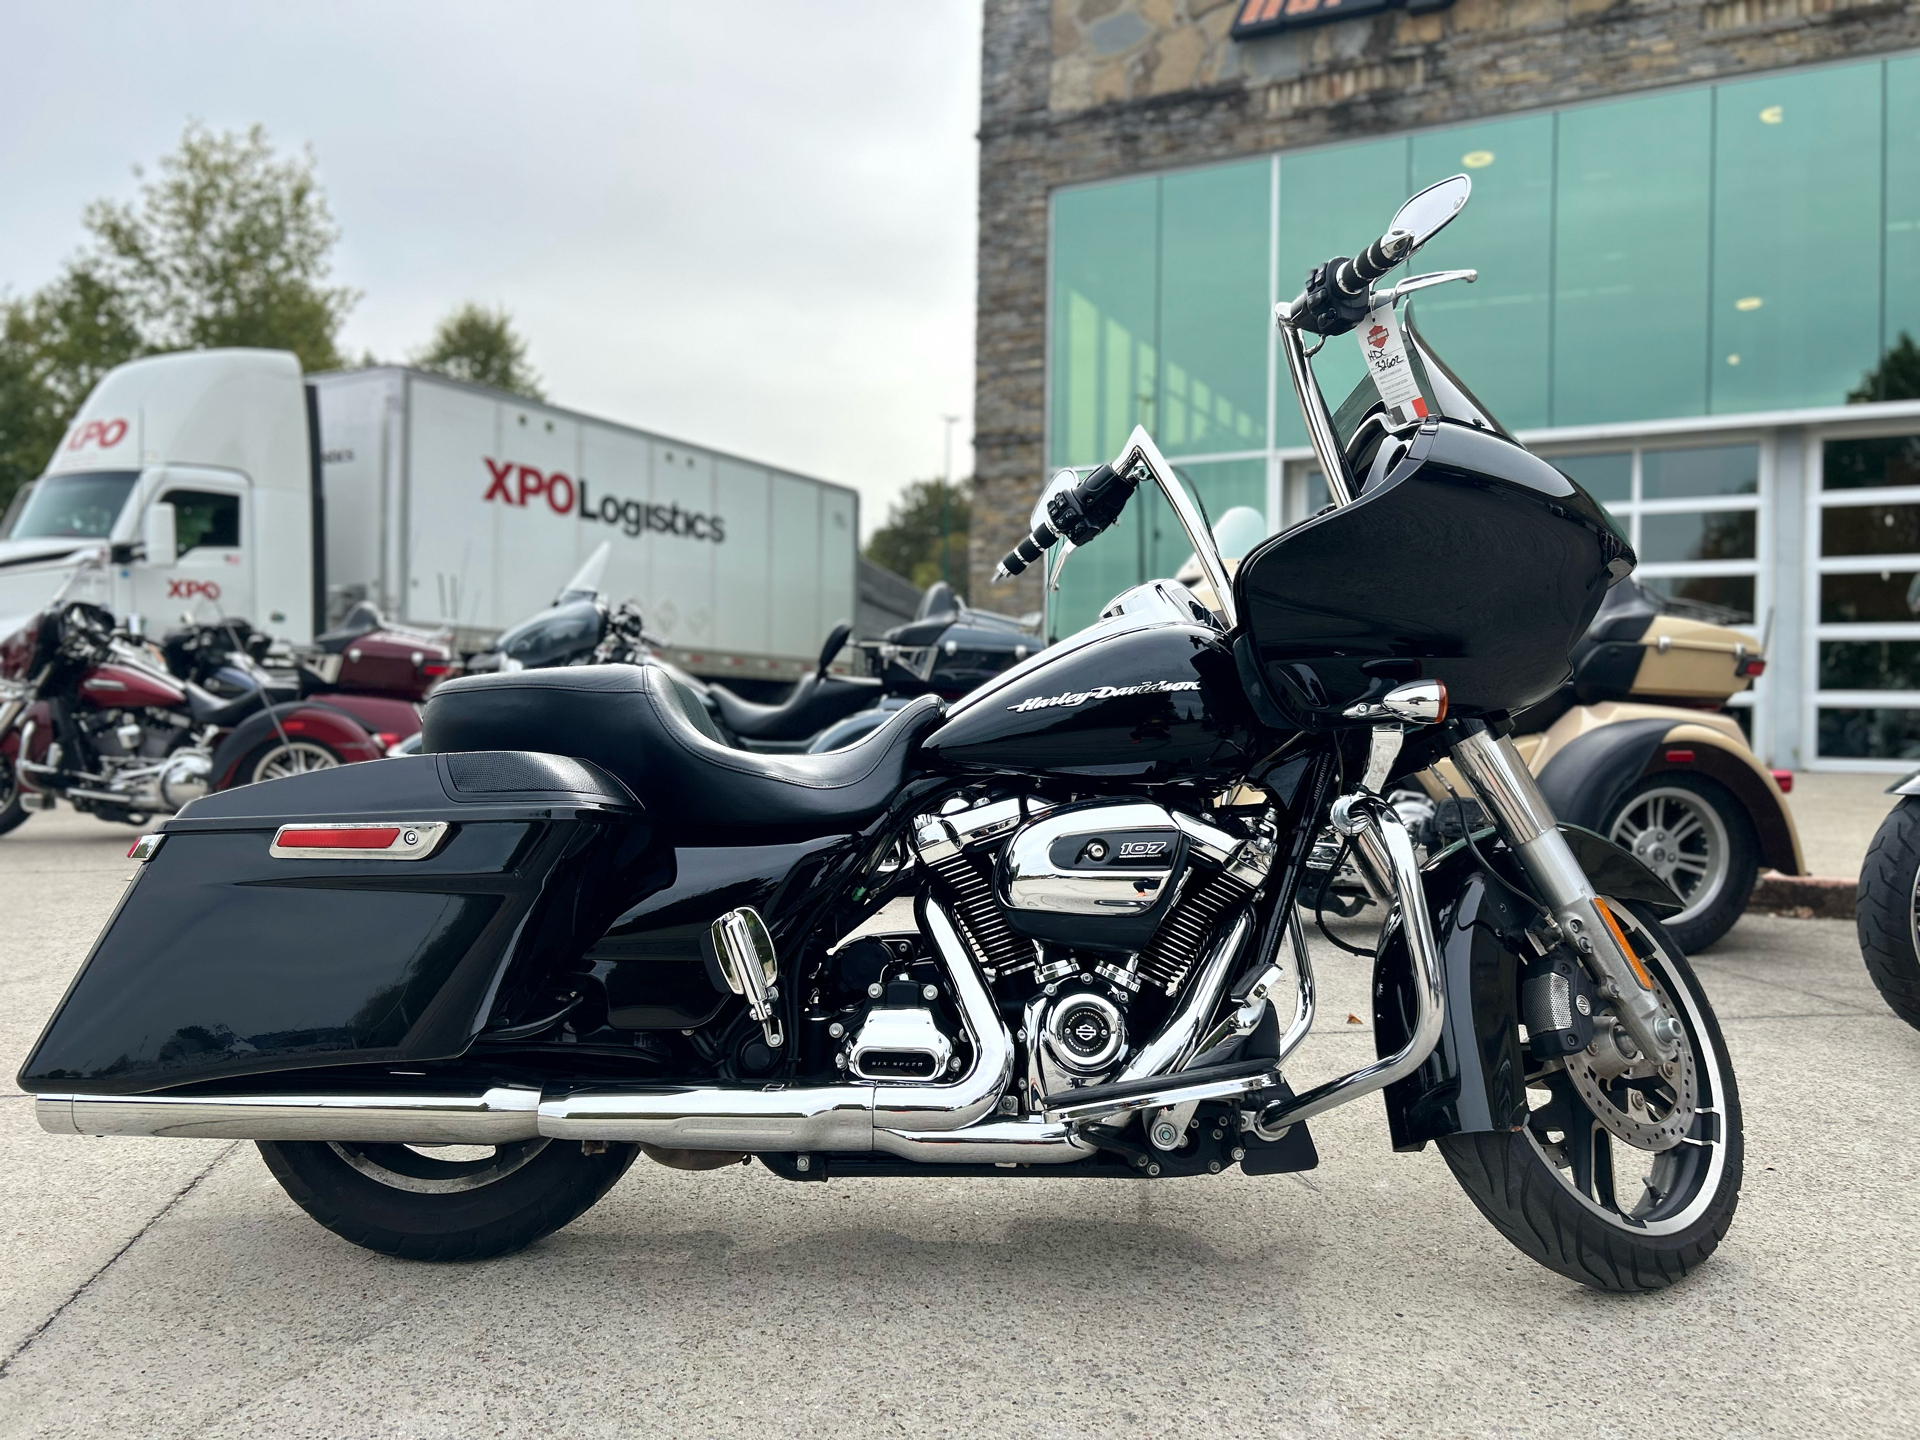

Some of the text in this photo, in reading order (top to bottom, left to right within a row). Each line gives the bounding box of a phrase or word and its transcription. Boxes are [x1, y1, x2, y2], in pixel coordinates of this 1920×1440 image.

[1368, 348, 1387, 361] HDC
[483, 456, 726, 544] XPO Logistics
[166, 578, 221, 601] XPO
[1006, 680, 1201, 712] Harley-Davidson
[1120, 841, 1167, 855] 107
